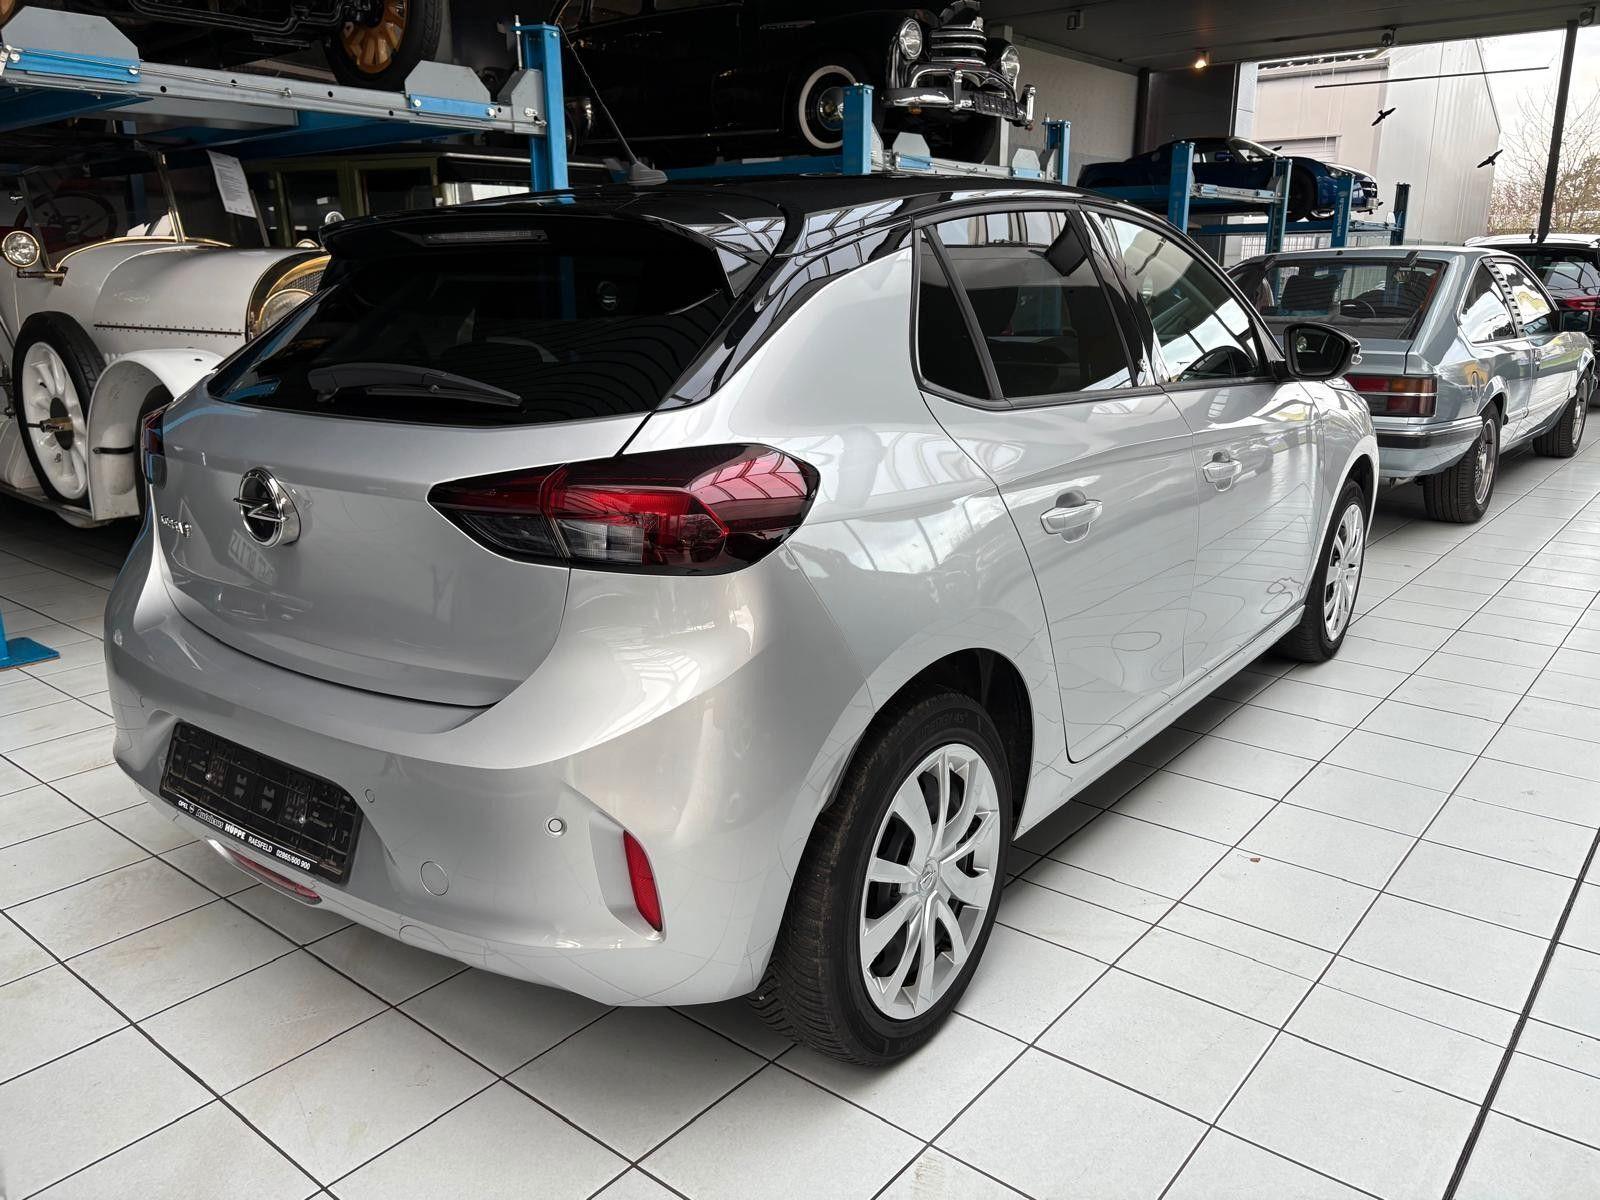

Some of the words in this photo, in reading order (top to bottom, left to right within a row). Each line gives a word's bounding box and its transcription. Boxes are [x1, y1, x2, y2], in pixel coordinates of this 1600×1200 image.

[178, 800, 189, 810] OPEL
[195, 808, 224, 829] Autohaus
[247, 835, 273, 853] RAESFELD
